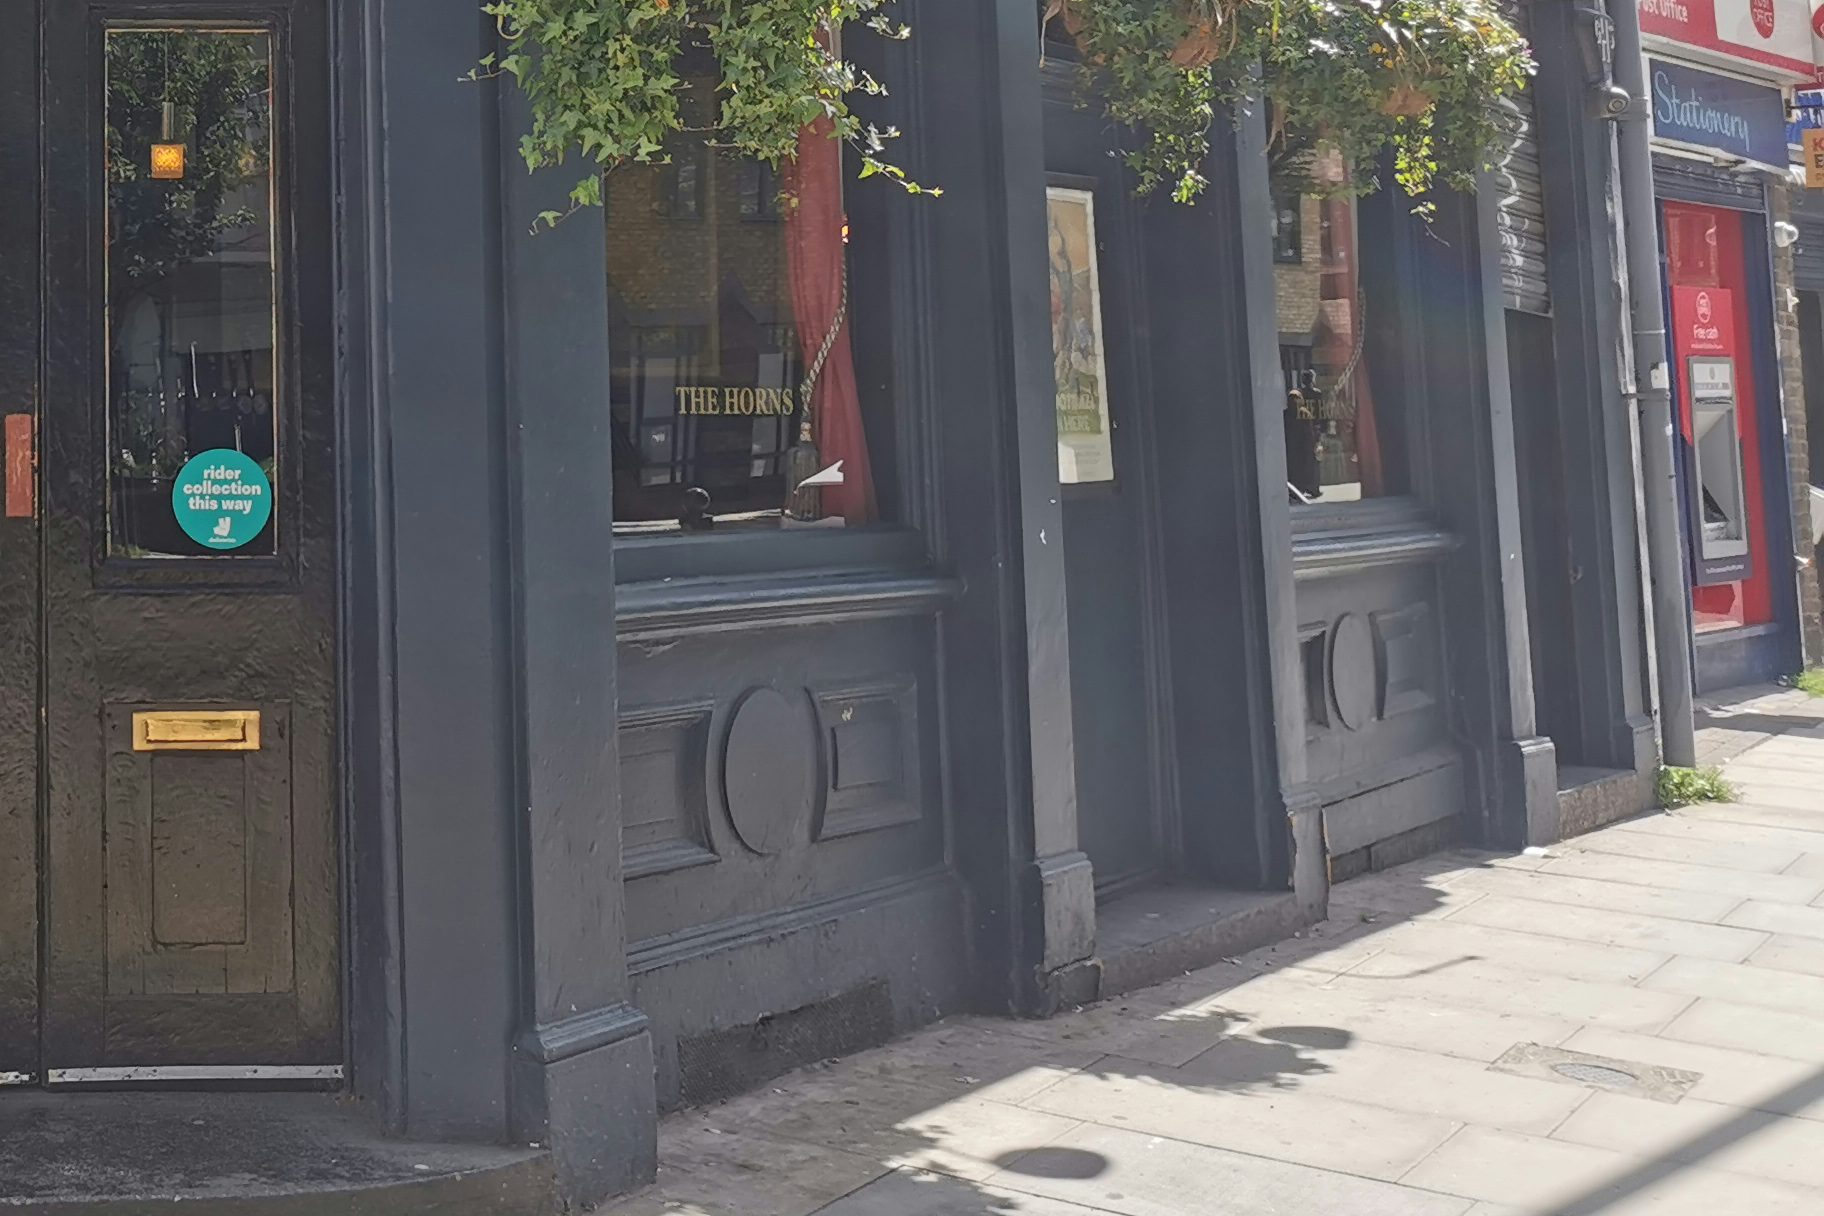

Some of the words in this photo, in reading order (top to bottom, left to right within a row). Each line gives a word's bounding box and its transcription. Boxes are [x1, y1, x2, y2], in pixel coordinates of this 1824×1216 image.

[1753, 8, 1773, 28] OFFICE
[1655, 70, 1750, 153] Stationery
[676, 386, 719, 414] THE
[724, 387, 794, 415] HORNS
[203, 465, 241, 480] rider
[183, 480, 262, 496] collection
[188, 496, 218, 511] this
[221, 498, 253, 515] way
